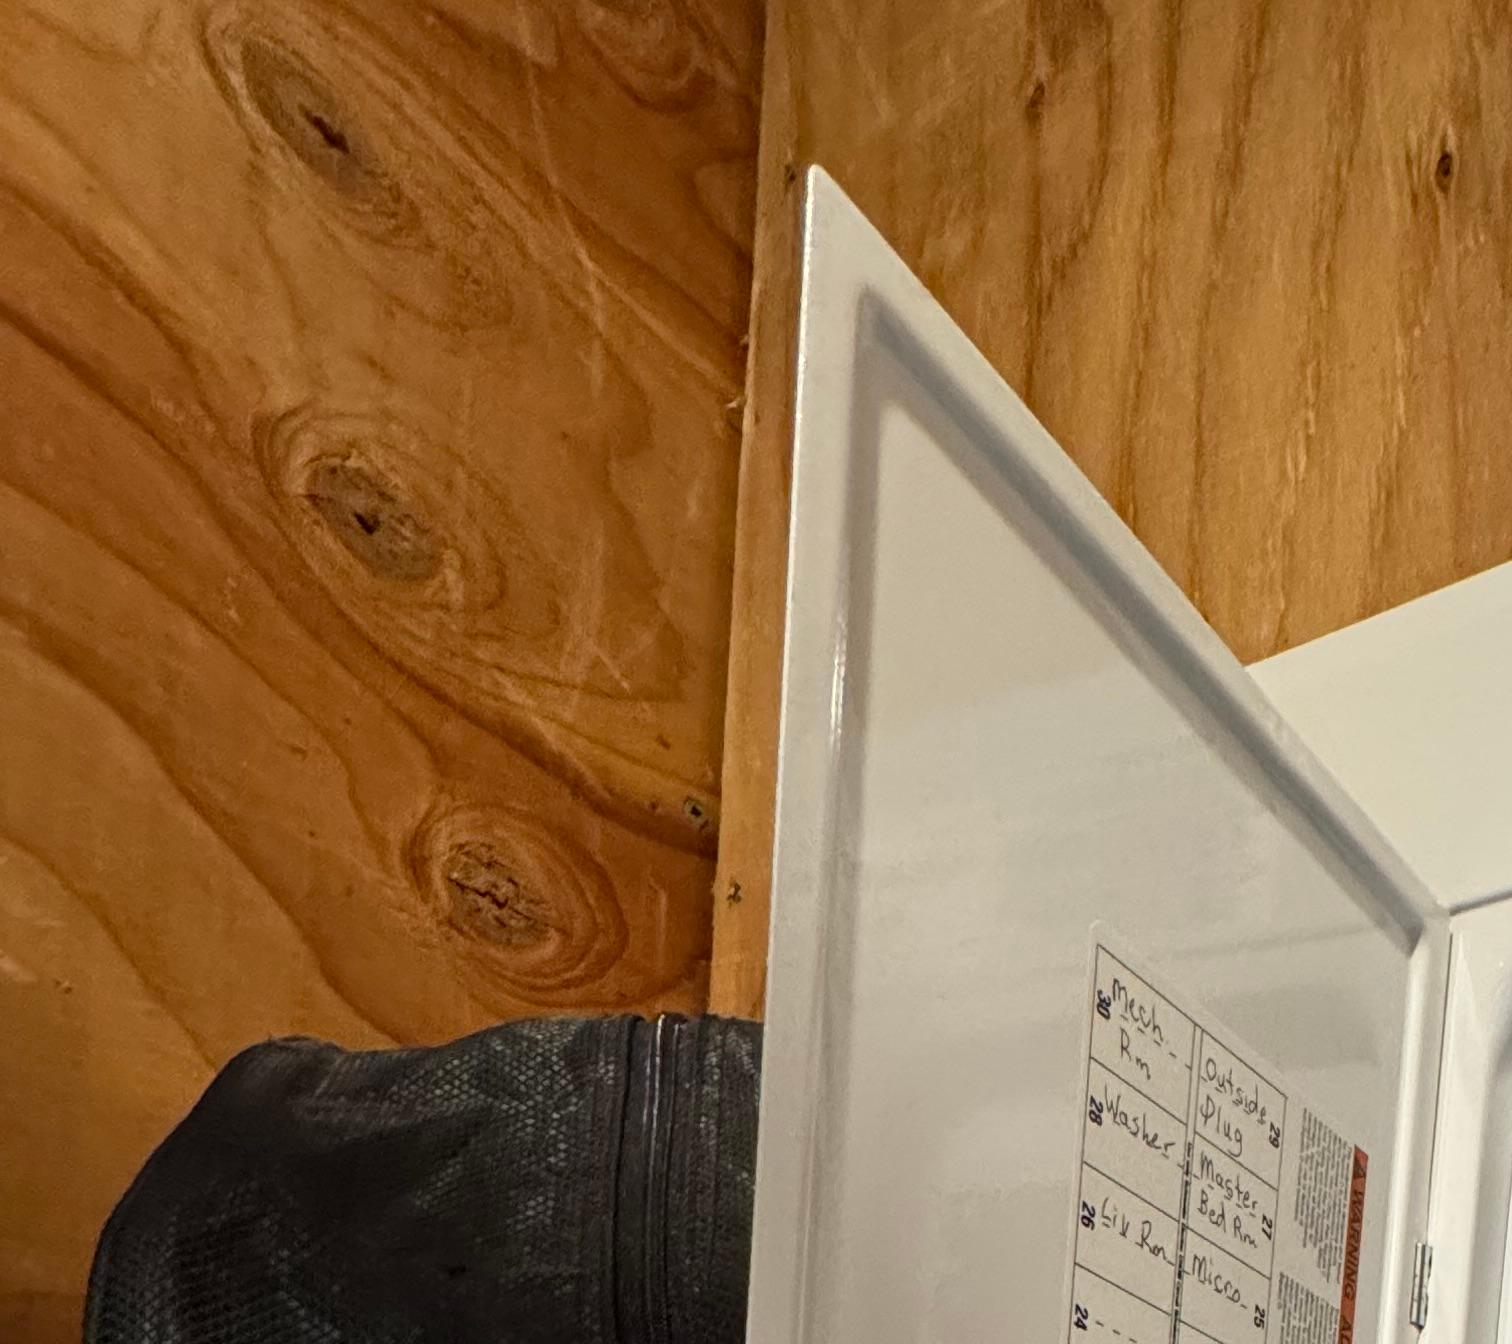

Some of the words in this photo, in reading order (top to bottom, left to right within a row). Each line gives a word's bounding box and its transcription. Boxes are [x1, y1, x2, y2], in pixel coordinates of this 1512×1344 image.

[1097, 989, 1111, 1020] 30
[1112, 978, 1164, 1042] Mech
[1120, 1027, 1151, 1081] Rm
[1089, 1095, 1104, 1127] 28
[1206, 1058, 1266, 1124] Outside
[1104, 1083, 1176, 1151] Washer
[1200, 1095, 1243, 1158] Plug
[1269, 1122, 1280, 1149] 29
[1200, 1150, 1258, 1210] Master
[1081, 1202, 1096, 1231] 26
[1199, 1189, 1227, 1233] Bed
[1233, 1215, 1258, 1249] Rm
[1262, 1214, 1273, 1241] 27
[1344, 1191, 1364, 1301] WARNING
[1191, 1254, 1241, 1303] Micro
[1074, 1304, 1088, 1331] 24
[1253, 1305, 1265, 1329] 25
